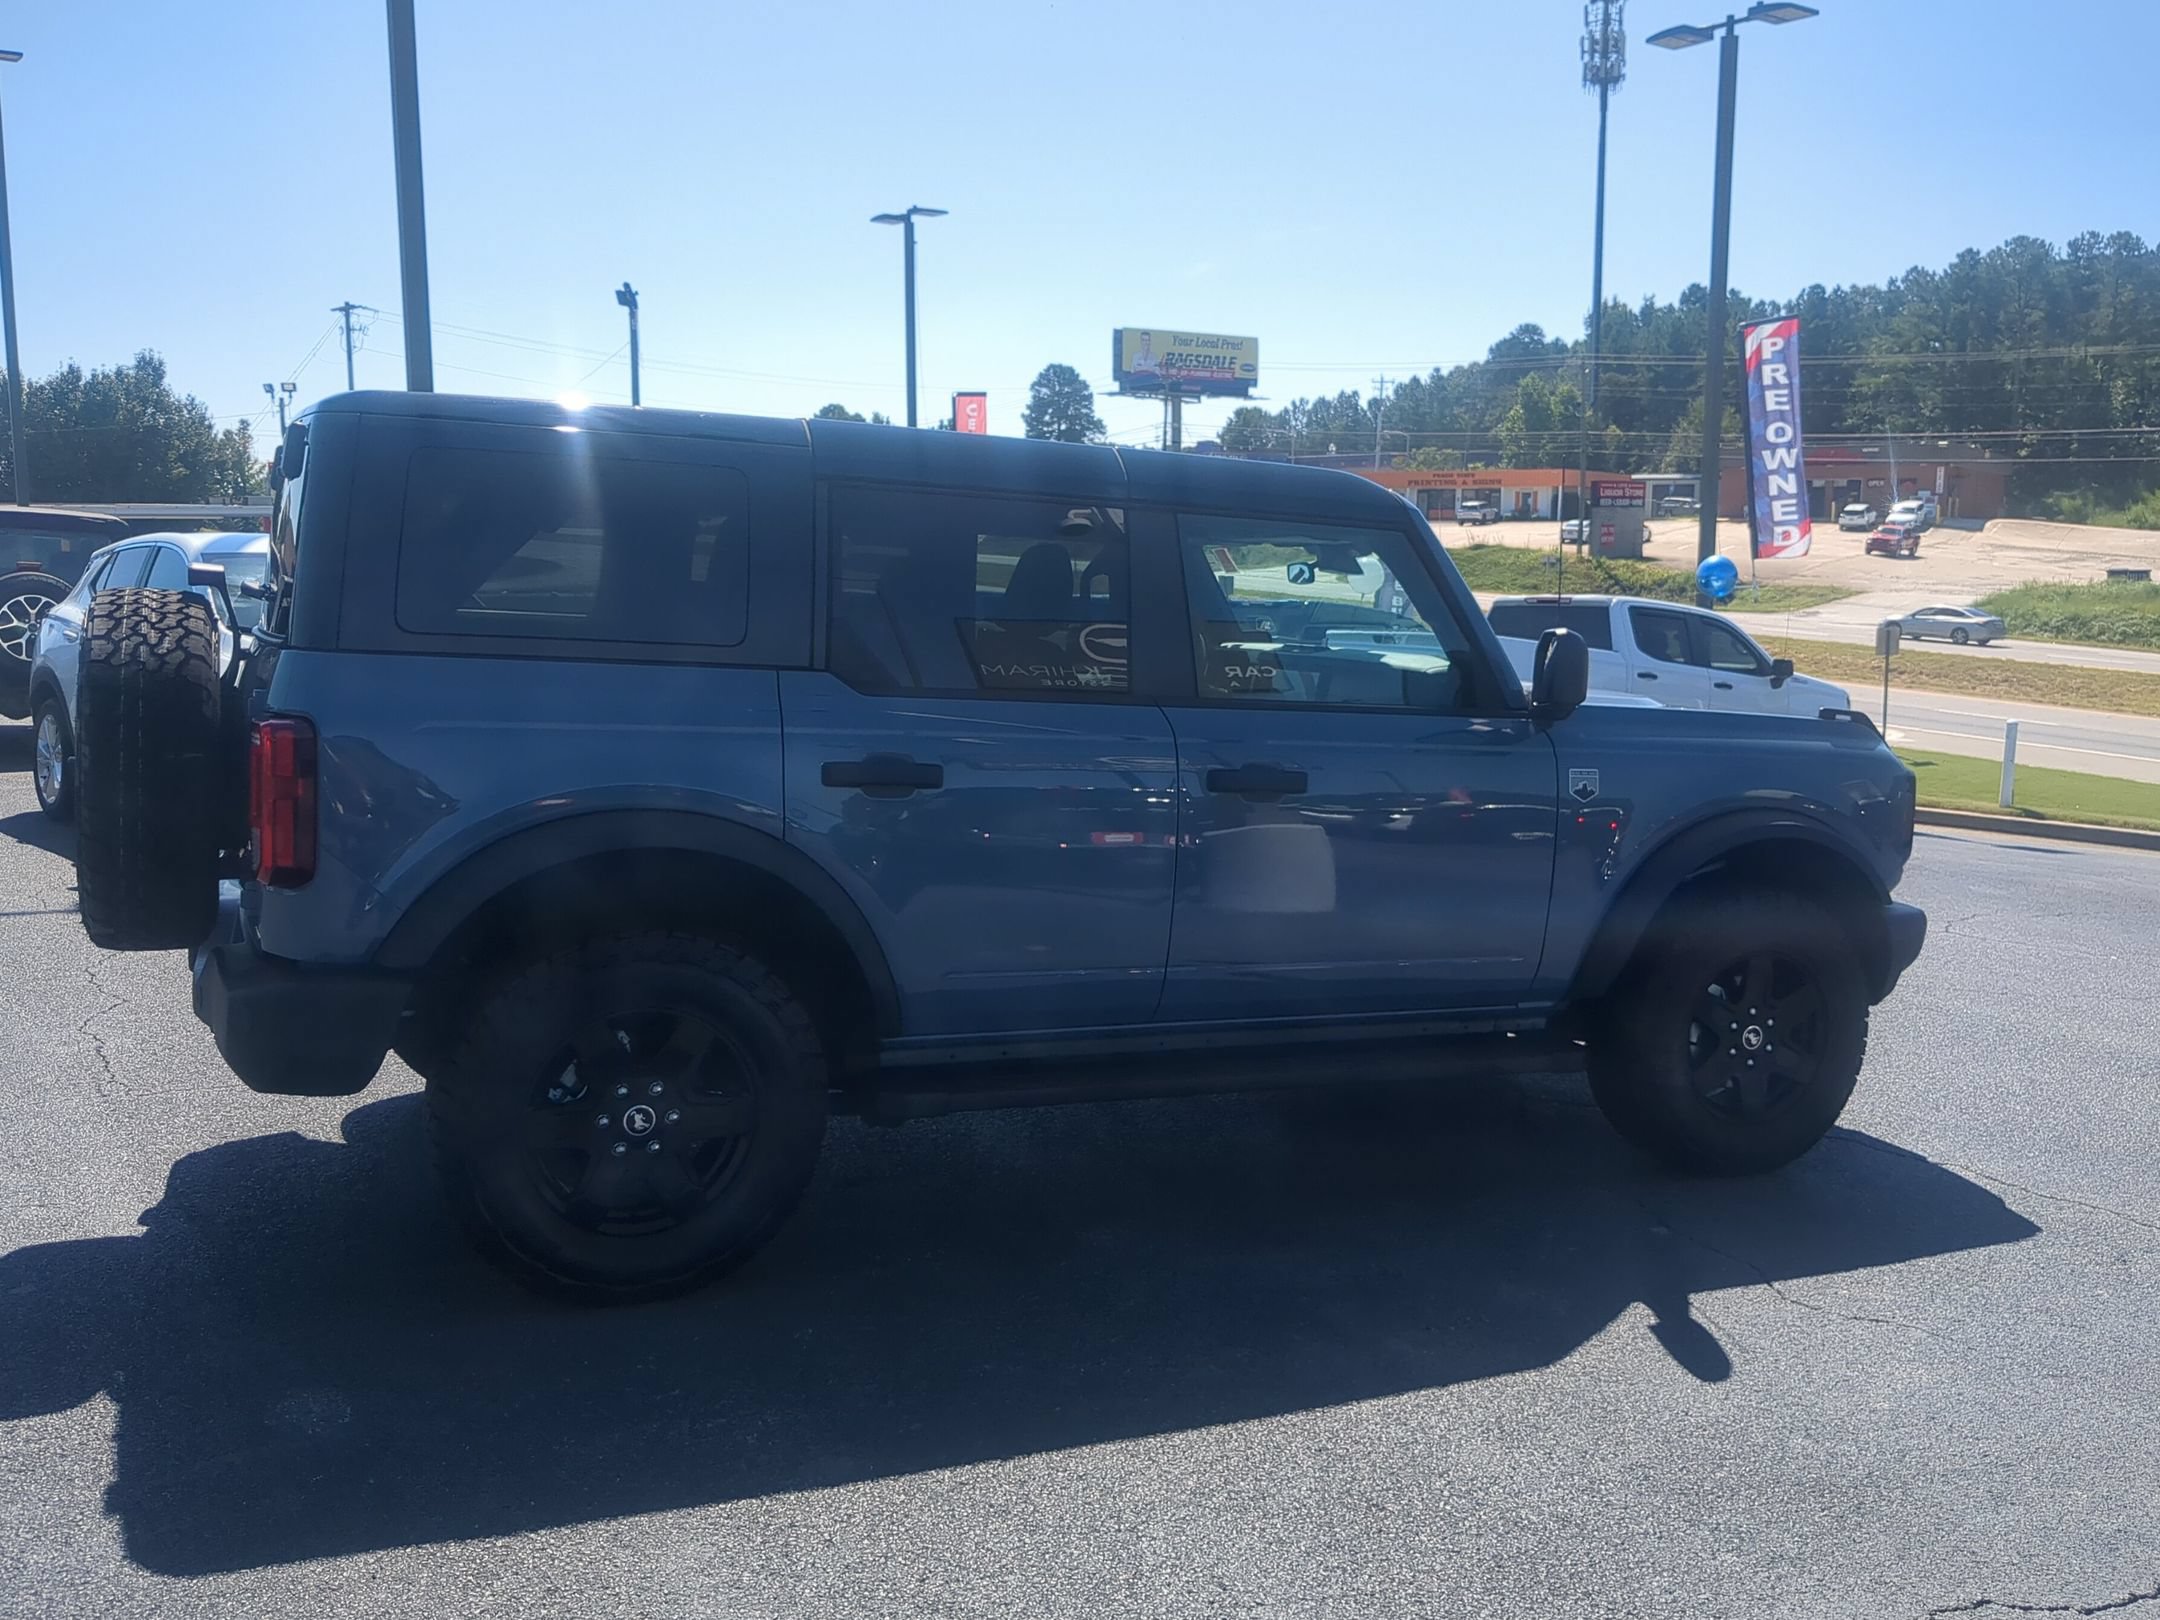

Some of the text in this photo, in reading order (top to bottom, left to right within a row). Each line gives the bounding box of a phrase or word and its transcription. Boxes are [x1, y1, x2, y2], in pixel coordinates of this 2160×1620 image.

[1172, 335, 1194, 347] Your
[1195, 337, 1219, 350] Local
[1165, 351, 1238, 370] RAGSDALE
[1761, 337, 1800, 547] PRE OWNED
